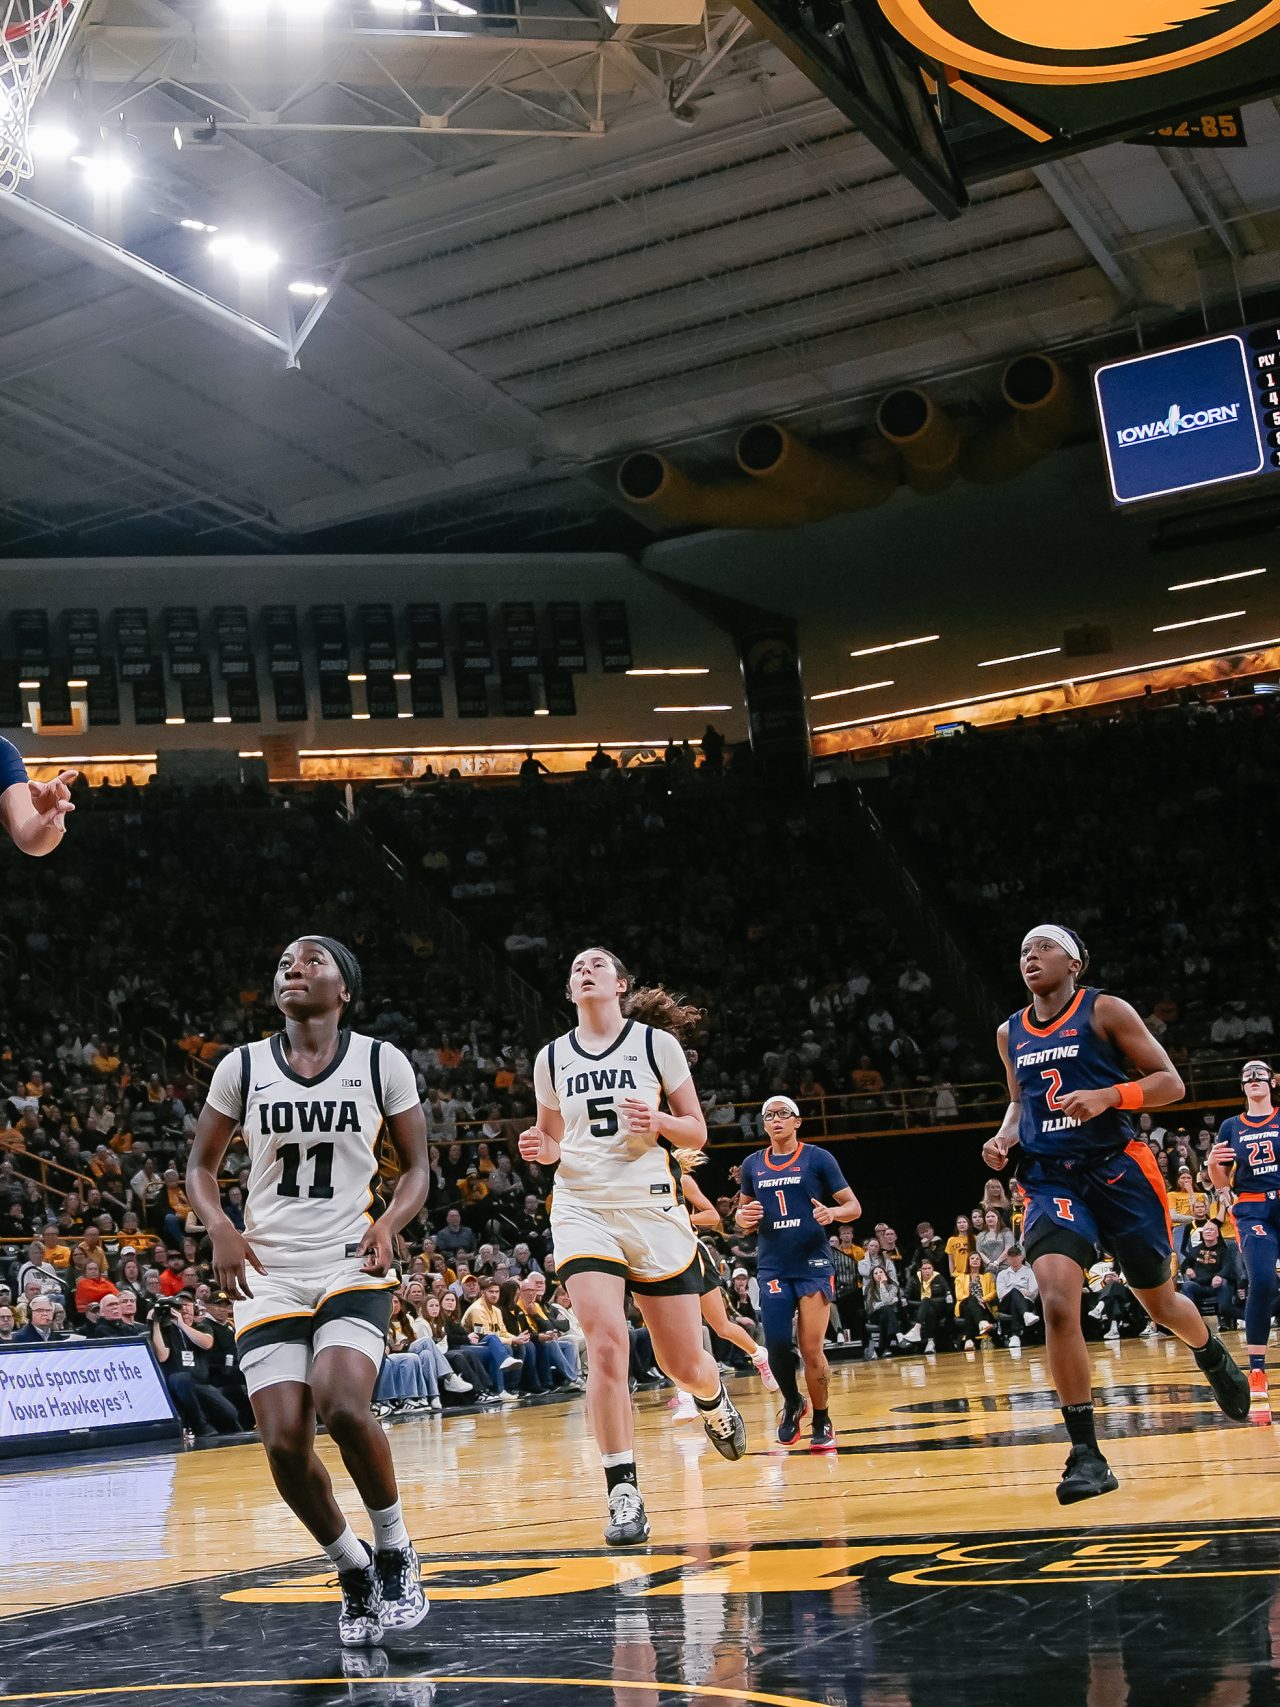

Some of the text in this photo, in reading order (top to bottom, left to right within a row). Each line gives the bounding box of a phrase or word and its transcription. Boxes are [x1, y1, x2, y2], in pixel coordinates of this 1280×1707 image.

[1258, 354, 1275, 368] PLY
[1266, 373, 1275, 387] 1
[1269, 391, 1278, 406] 4
[1117, 403, 1238, 444] IOWA CORN
[1016, 1045, 1079, 1068] FIGHTING
[567, 1069, 637, 1097] IOWA
[1041, 1068, 1063, 1111] 2
[259, 1101, 362, 1135] IOWA
[587, 1096, 619, 1138] 5
[1239, 1131, 1279, 1143] FIGHTING
[1246, 1140, 1276, 1166] 23
[276, 1142, 335, 1199] 11
[1253, 1164, 1278, 1176] ILLINI
[758, 1176, 801, 1189] FIGHTING
[775, 1190, 788, 1216] 1
[773, 1219, 801, 1230] ILLINI
[46, 1368, 101, 1391] sponsor
[104, 1362, 117, 1382] of
[118, 1361, 142, 1380] the
[8, 1400, 48, 1421] Iowa
